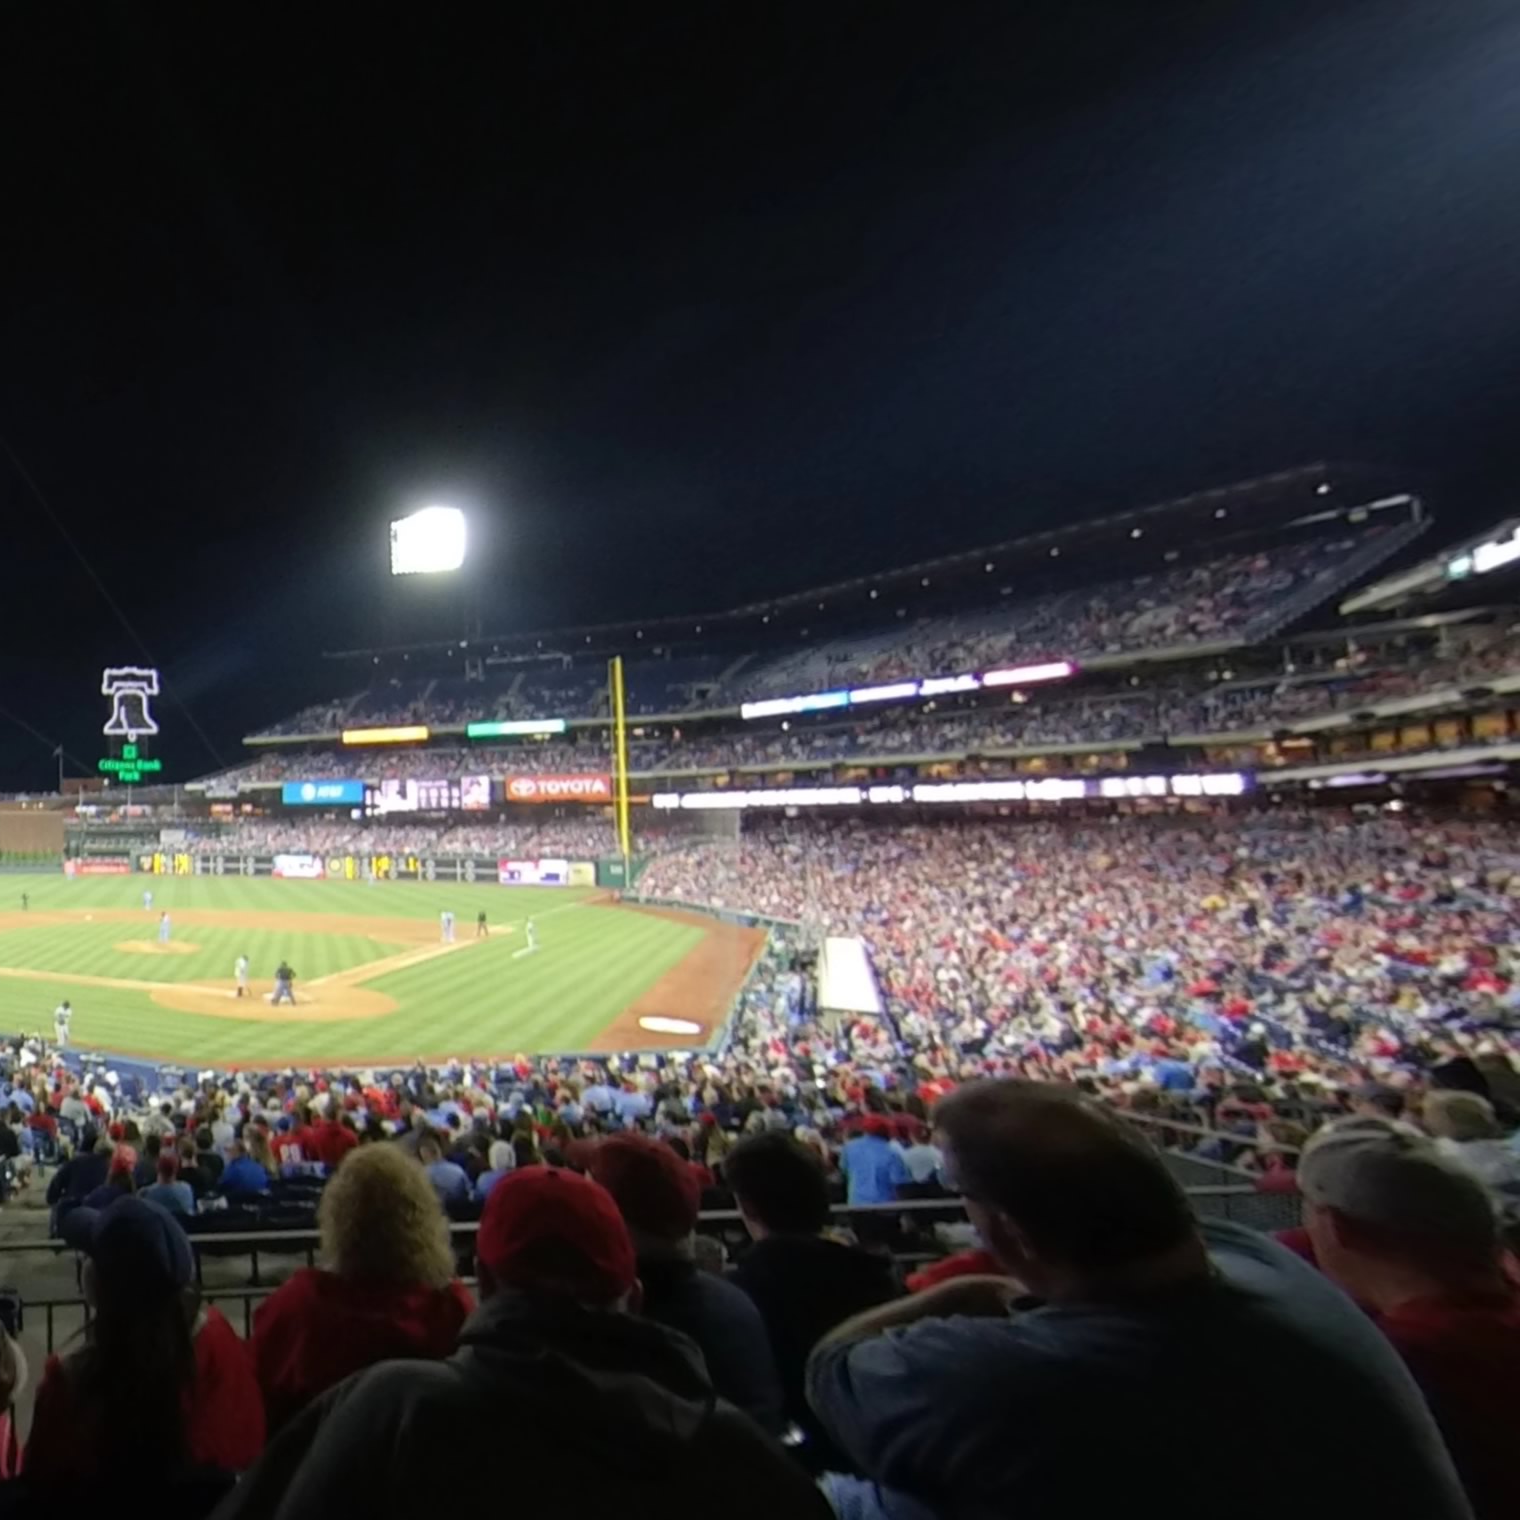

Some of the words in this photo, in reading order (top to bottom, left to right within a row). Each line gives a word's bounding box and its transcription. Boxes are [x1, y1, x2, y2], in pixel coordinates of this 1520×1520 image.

[98, 759, 135, 771] Citizens
[136, 759, 161, 771] Bank
[119, 770, 141, 781] Park
[537, 777, 604, 795] TOYOTA
